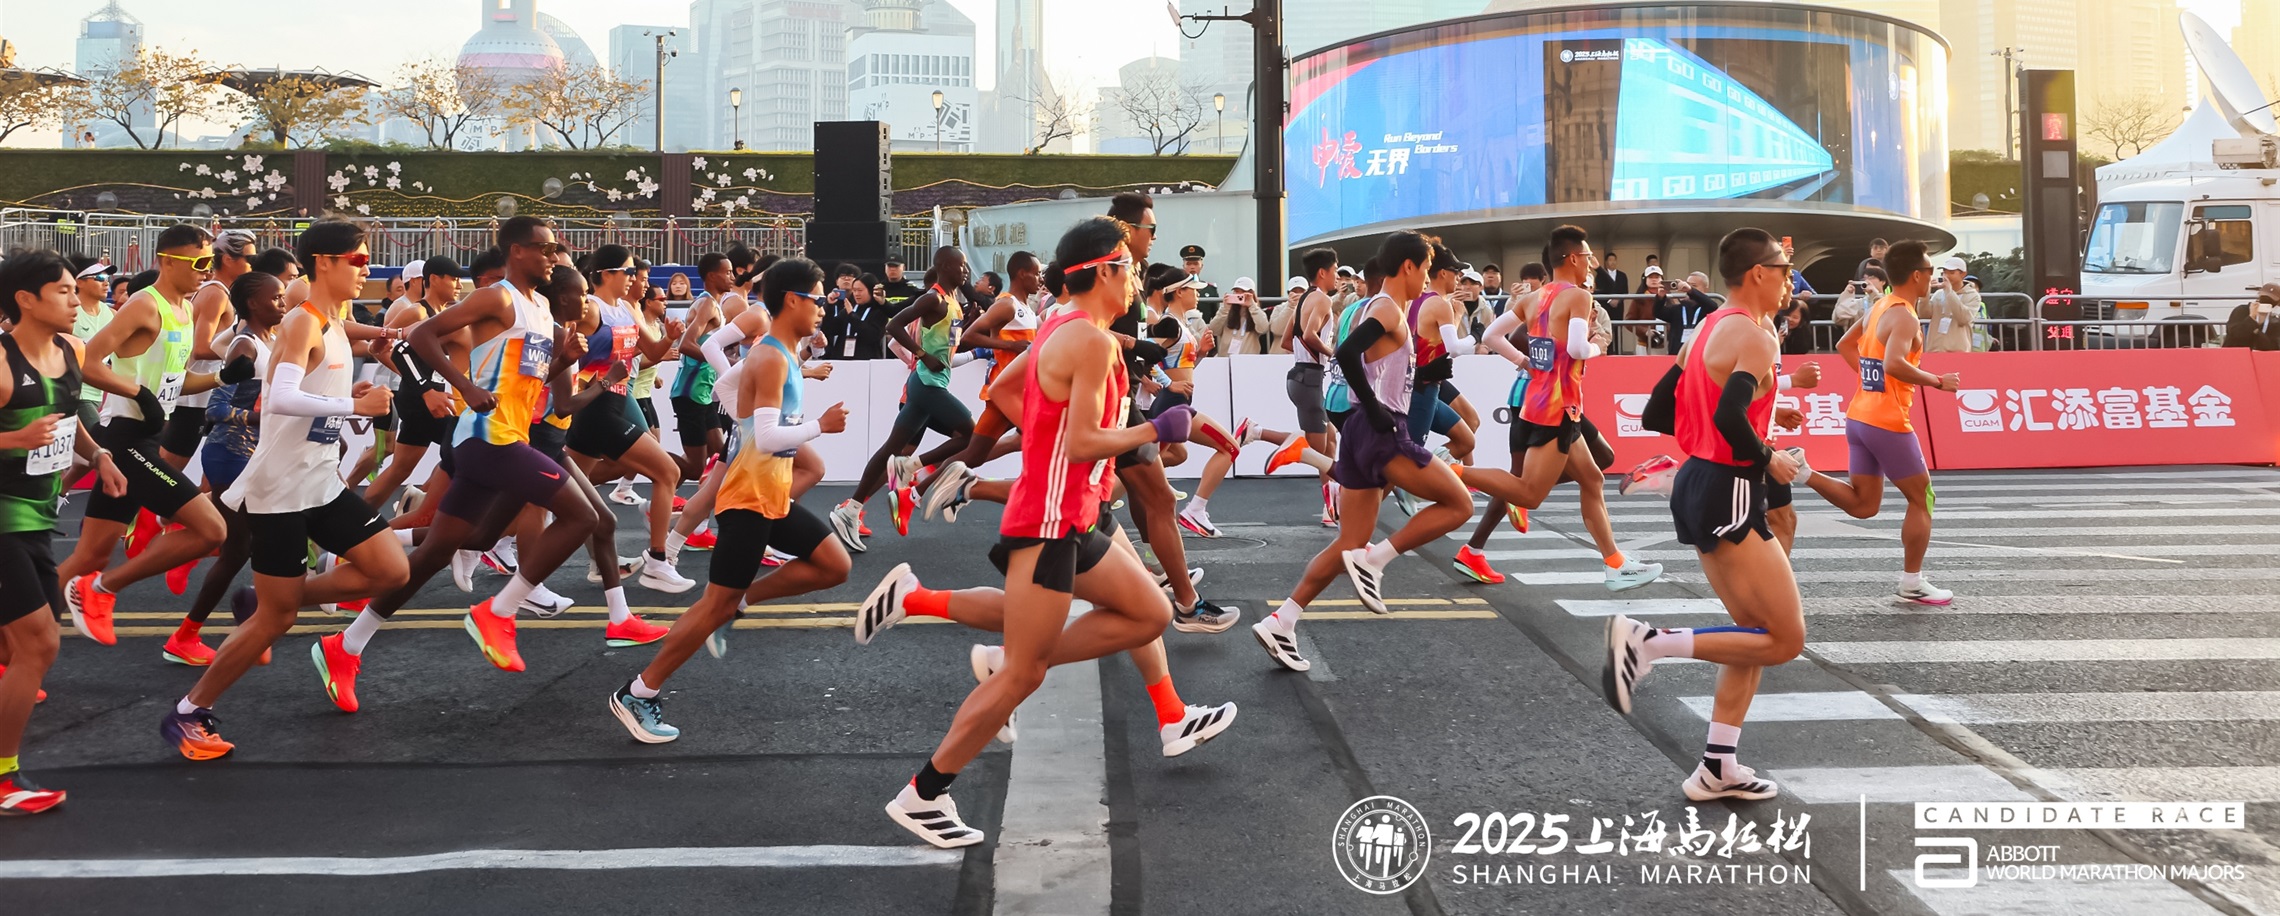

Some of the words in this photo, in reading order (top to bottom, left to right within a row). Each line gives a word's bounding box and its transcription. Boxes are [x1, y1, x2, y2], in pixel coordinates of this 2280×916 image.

[1384, 133, 1402, 143] Run
[1403, 131, 1443, 144] Beyond
[1414, 144, 1458, 154] Borders
[1662, 175, 1696, 197] GO
[1703, 174, 1726, 192] GO
[1531, 346, 1548, 360] 1101
[2005, 384, 2236, 432] 汇添富基金
[1621, 424, 1644, 432] CUA
[1964, 419, 2000, 428] CUAM
[144, 461, 178, 487] RUNNING
